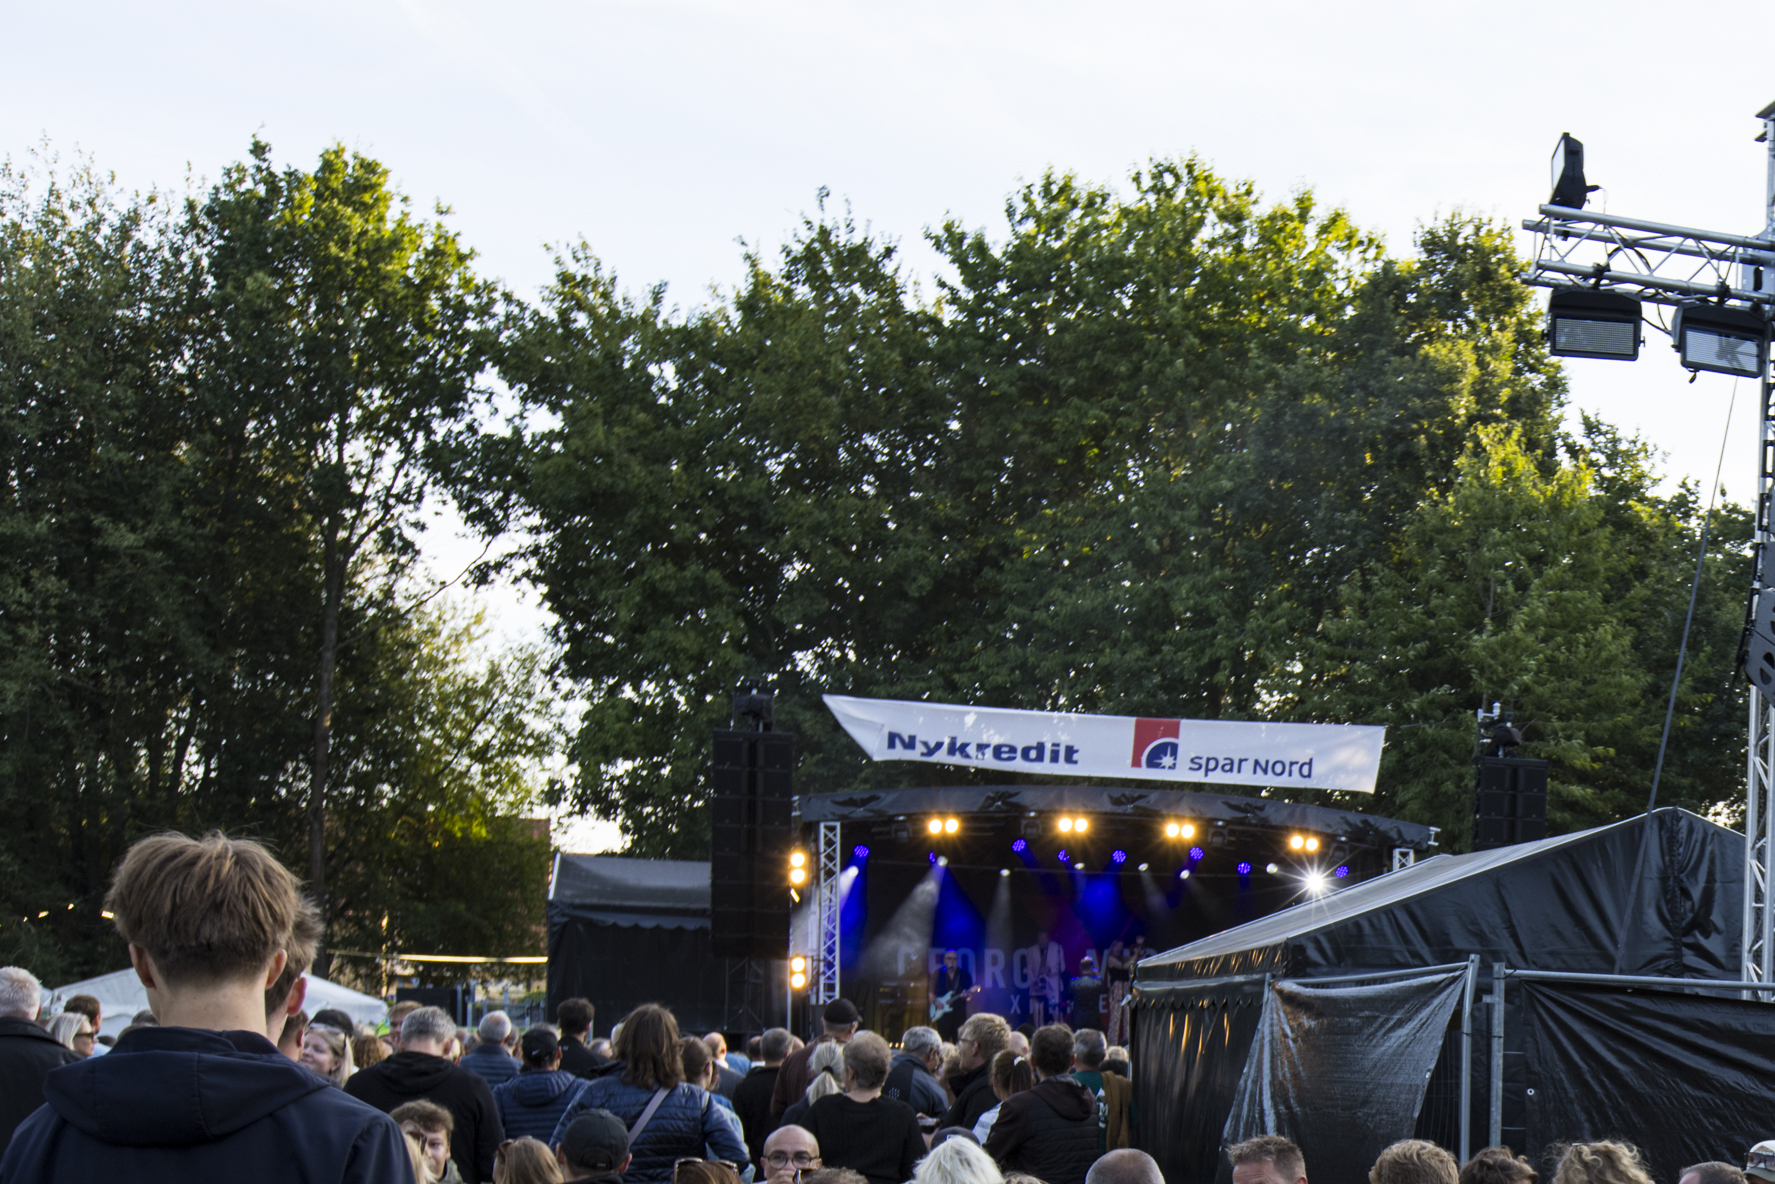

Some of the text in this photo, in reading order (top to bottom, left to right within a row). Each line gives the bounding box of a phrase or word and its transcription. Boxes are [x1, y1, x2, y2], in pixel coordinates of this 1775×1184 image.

[887, 731, 1079, 765] Nykredit
[1188, 753, 1313, 780] spar Nord
